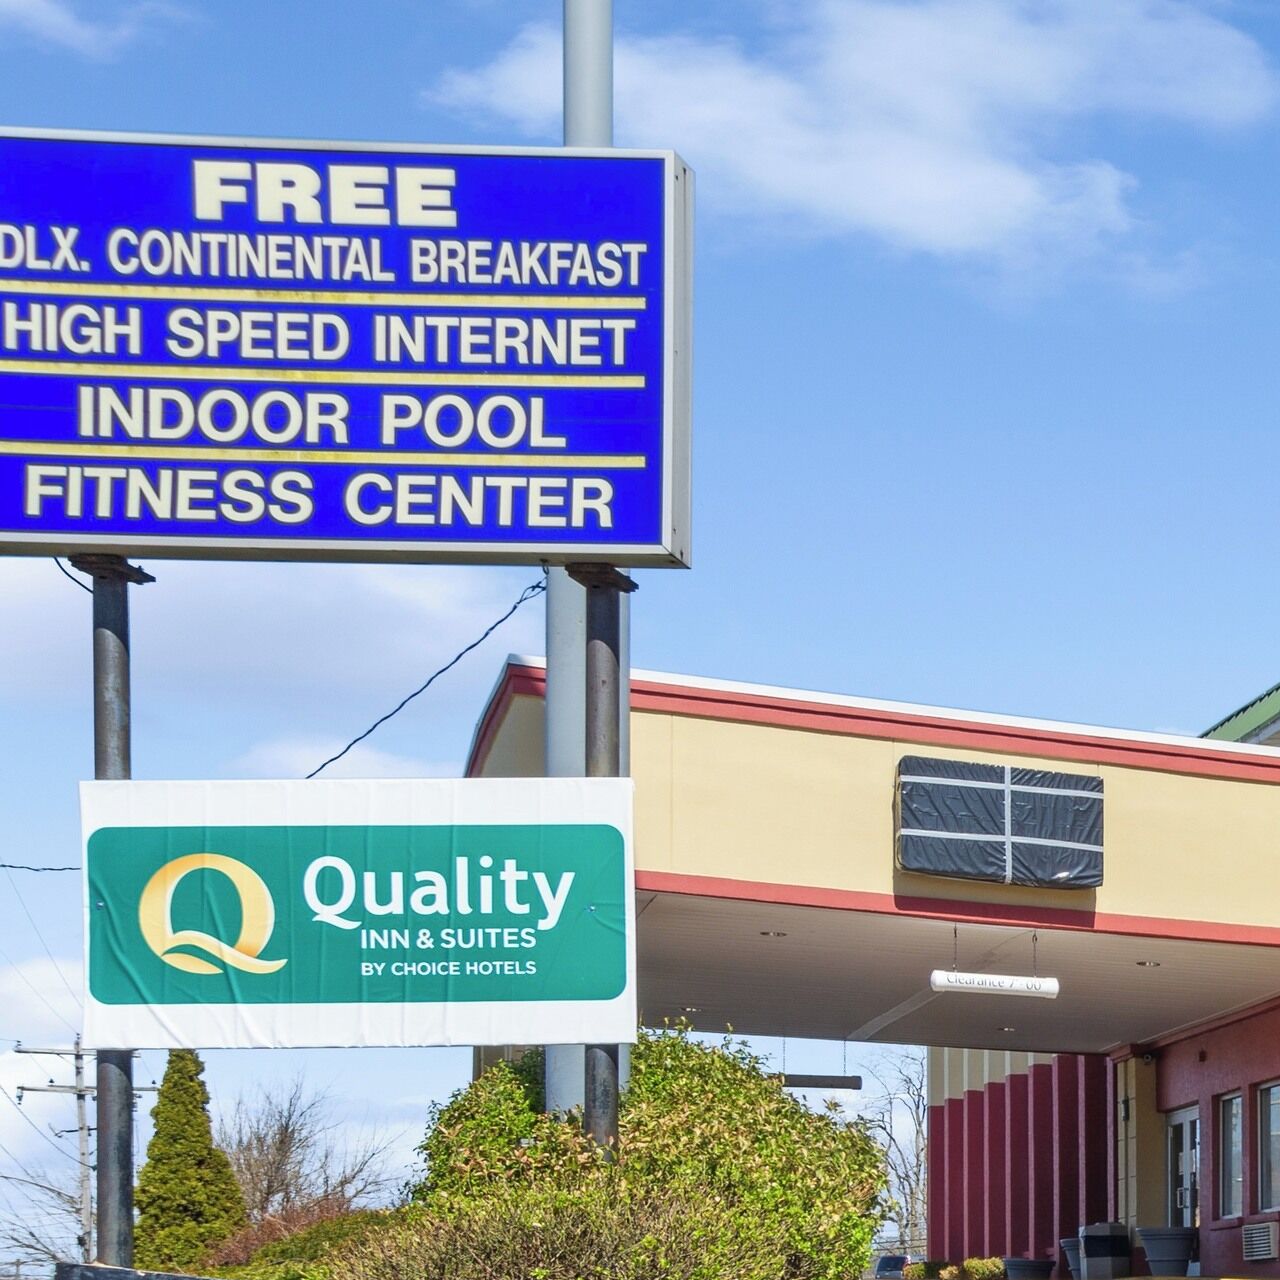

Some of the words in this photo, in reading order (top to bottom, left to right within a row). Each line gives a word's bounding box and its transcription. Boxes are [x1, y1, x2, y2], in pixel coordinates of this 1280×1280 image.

[192, 160, 458, 227] FREE
[0, 223, 91, 272] DLX.
[107, 227, 395, 282] CONTINENTAL
[410, 239, 648, 287] BREAKFAST
[4, 301, 141, 355] HIGH
[166, 308, 351, 361] SPEED
[373, 315, 636, 365] INTERNET
[78, 385, 350, 445] INDOOR
[381, 394, 568, 449] POOL
[24, 464, 315, 524] FITNESS
[344, 472, 615, 528] CENTER
[303, 855, 576, 931] Quality
[361, 928, 410, 949] INN
[416, 928, 435, 949] &
[440, 927, 537, 949] SUITES
[361, 962, 386, 976] BY
[391, 961, 461, 976] CHOICE
[466, 960, 537, 976] HOTELS
[946, 973, 1005, 988] Clearance
